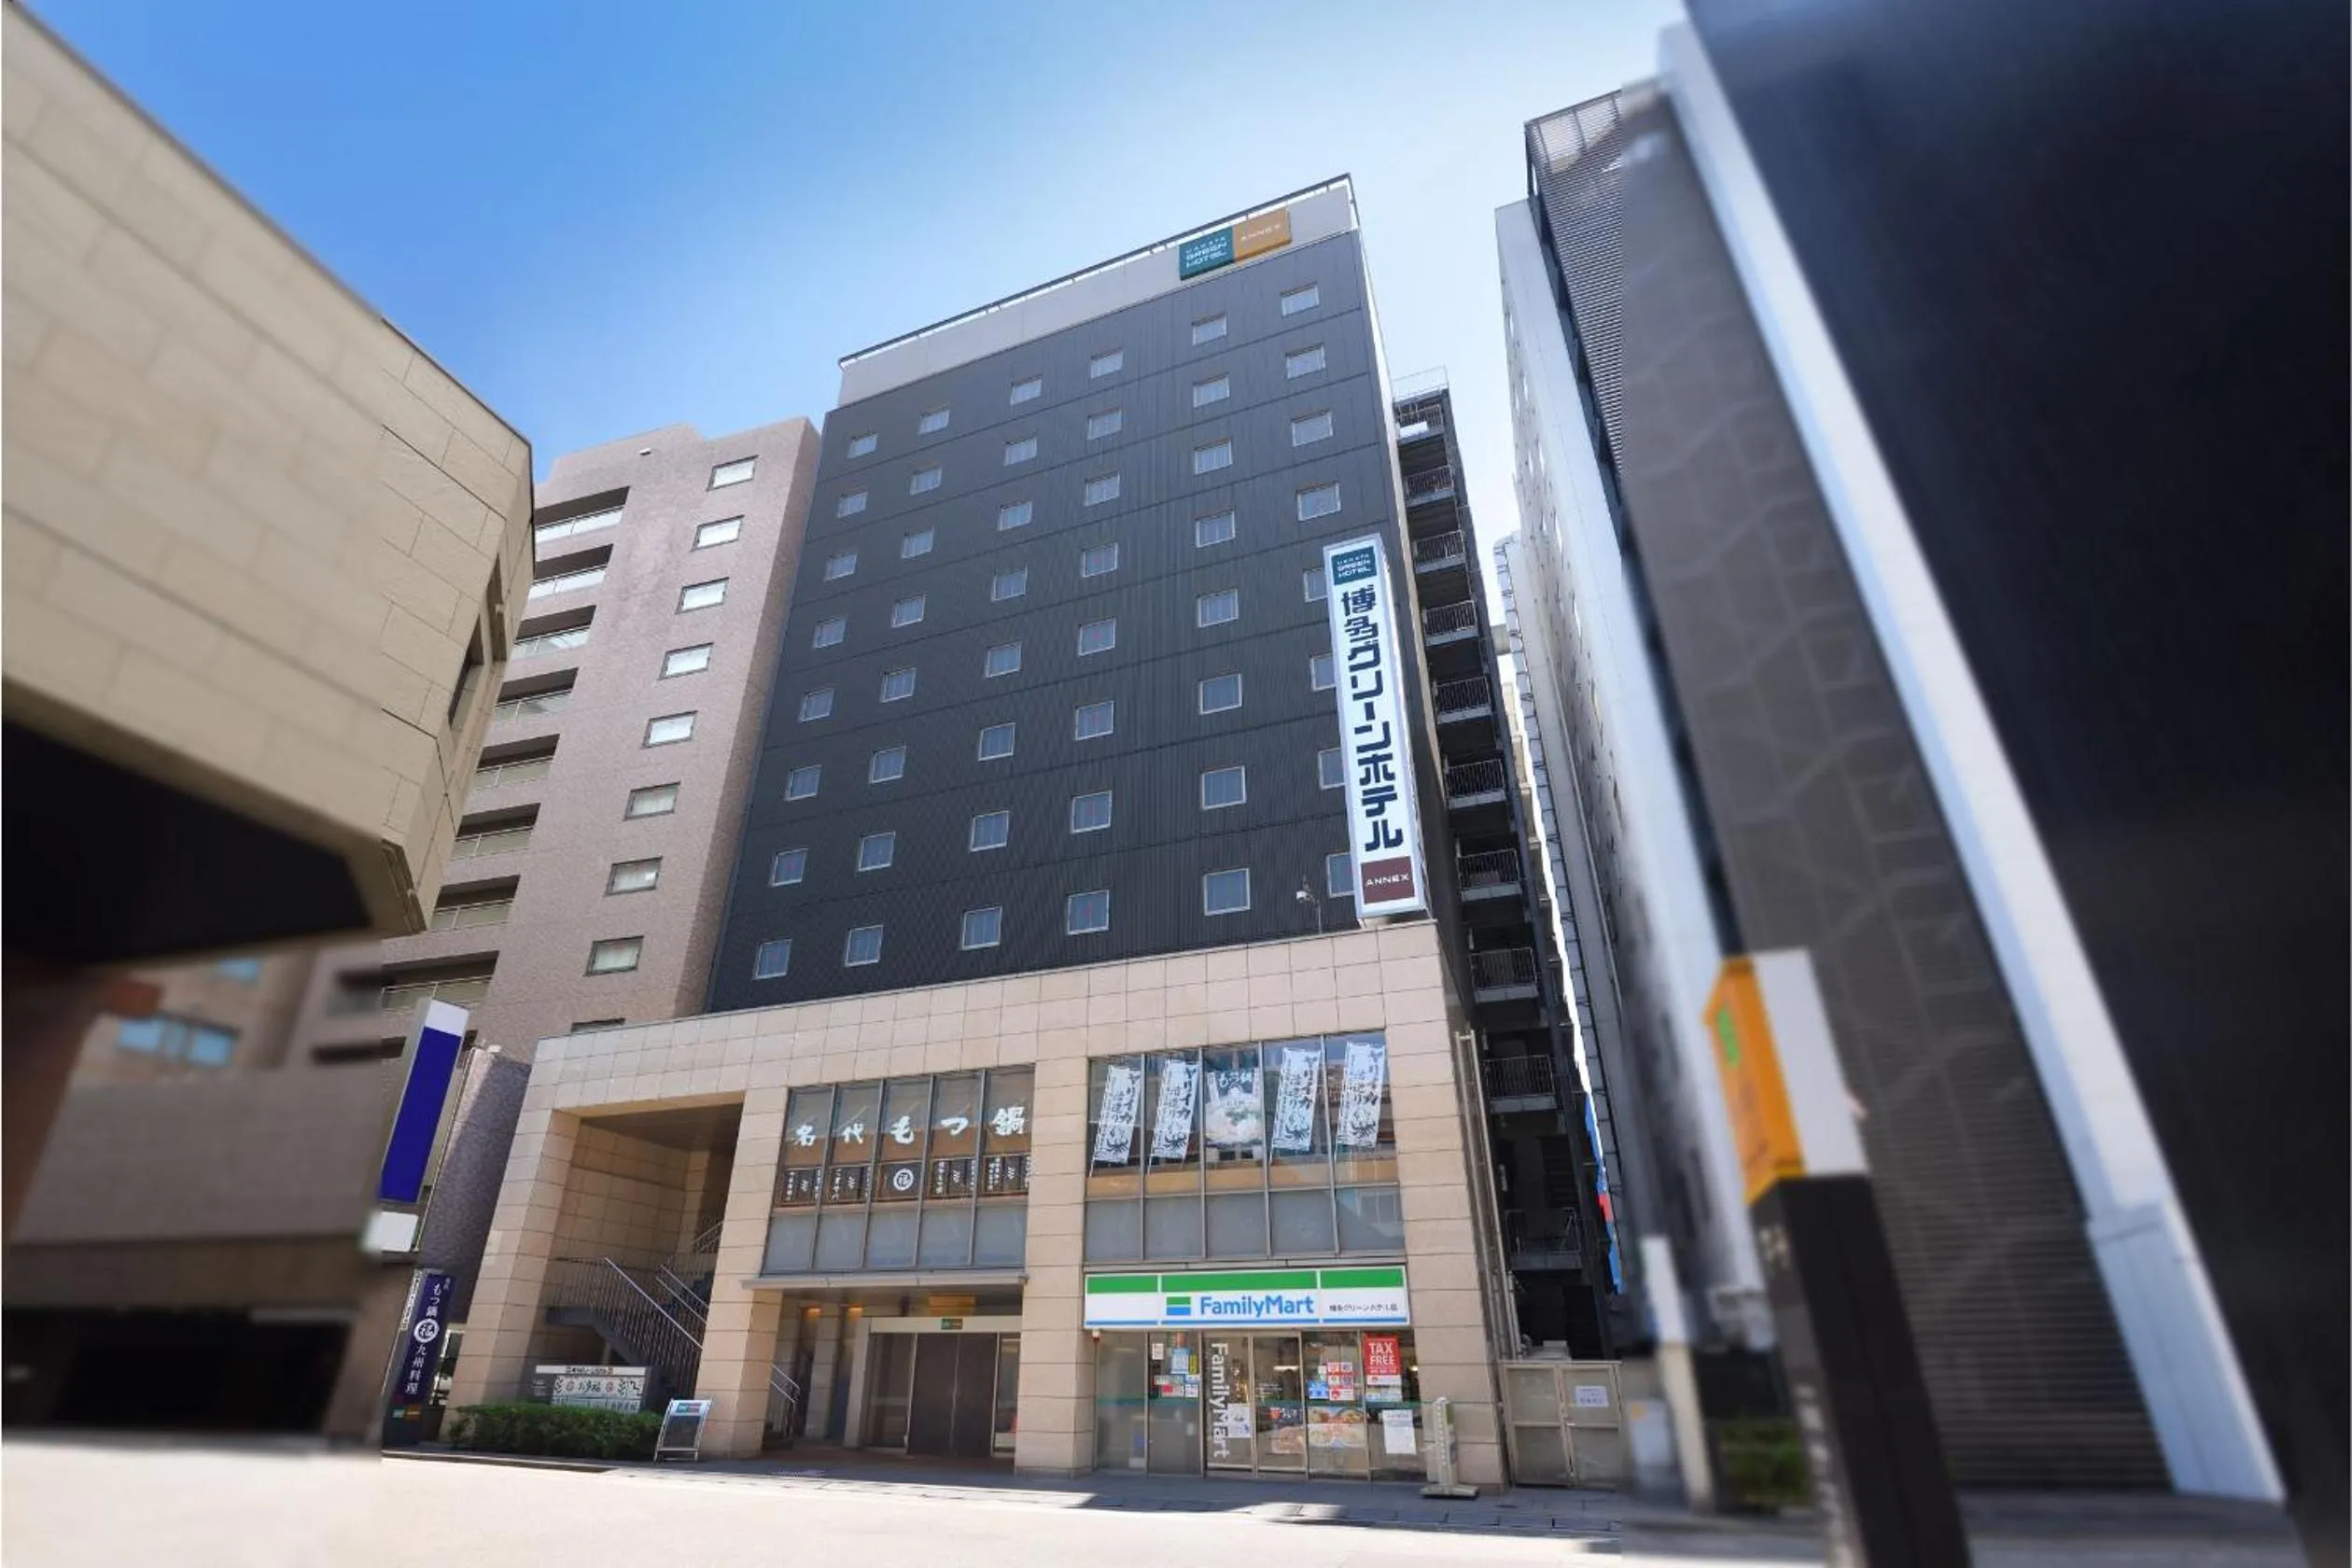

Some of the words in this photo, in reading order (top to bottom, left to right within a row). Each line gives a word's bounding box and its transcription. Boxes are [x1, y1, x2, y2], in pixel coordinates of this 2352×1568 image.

[1338, 567, 1371, 578] HOTEL
[1340, 584, 1404, 852] 博多グリーンホテル
[1365, 874, 1409, 888] ANNEX
[795, 1106, 1026, 1146] 名代もつ鍋
[1200, 1295, 1314, 1318] FamilyMart
[1368, 1342, 1393, 1354] TAX
[1369, 1354, 1395, 1365] FREE
[405, 1344, 427, 1395] 九州料理
[1209, 1343, 1230, 1458] FamilyMart
